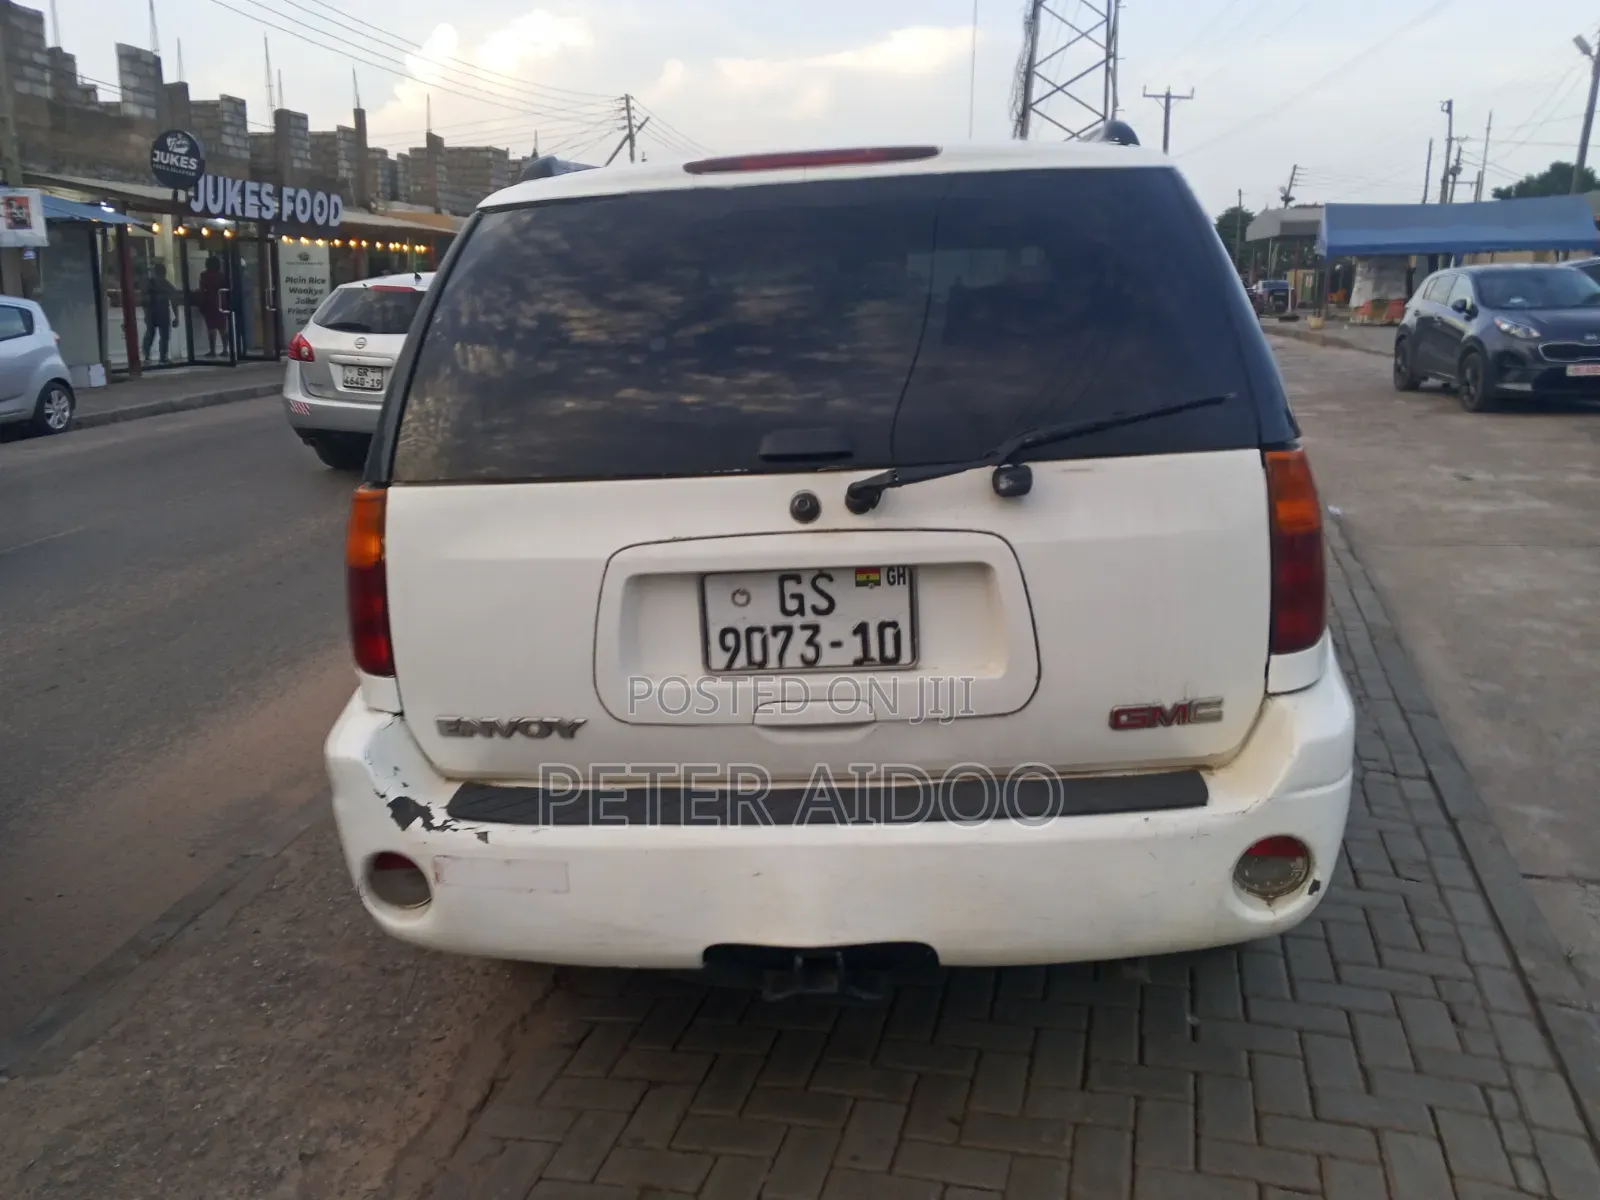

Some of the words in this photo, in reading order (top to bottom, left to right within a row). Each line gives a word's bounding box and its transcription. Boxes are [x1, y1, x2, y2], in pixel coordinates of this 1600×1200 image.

[152, 150, 198, 170] JUKES
[190, 174, 275, 220] JUKES
[281, 186, 344, 227] FOOD
[285, 276, 307, 284] Plain
[308, 276, 327, 284] Rice
[778, 572, 836, 617] GS
[887, 566, 907, 586] GH
[718, 620, 901, 671] 9073-10
[435, 715, 589, 740] ENVOY
[1108, 696, 1225, 732] GMC
